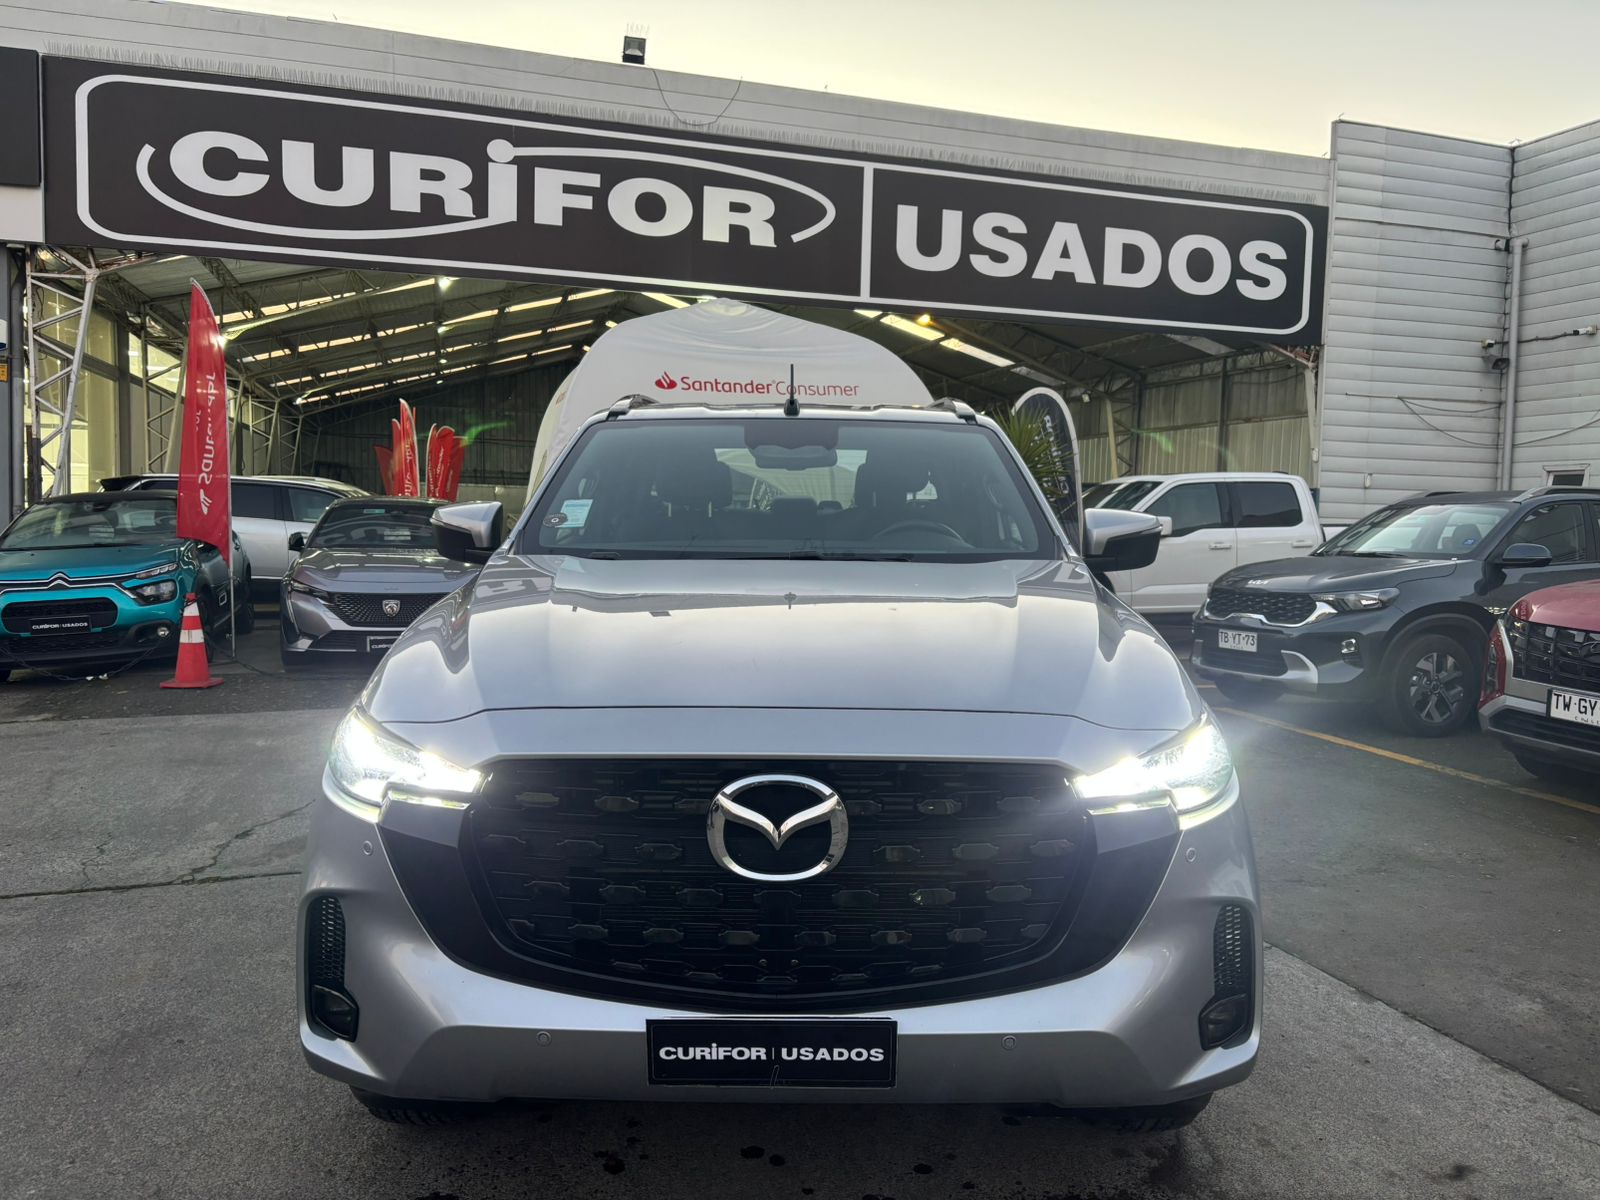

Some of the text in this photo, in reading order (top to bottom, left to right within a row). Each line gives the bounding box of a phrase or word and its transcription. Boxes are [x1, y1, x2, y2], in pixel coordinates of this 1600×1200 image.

[895, 203, 1288, 301] USADOS
[680, 376, 860, 397] Santander Consumer
[781, 1047, 885, 1062] USADOS
